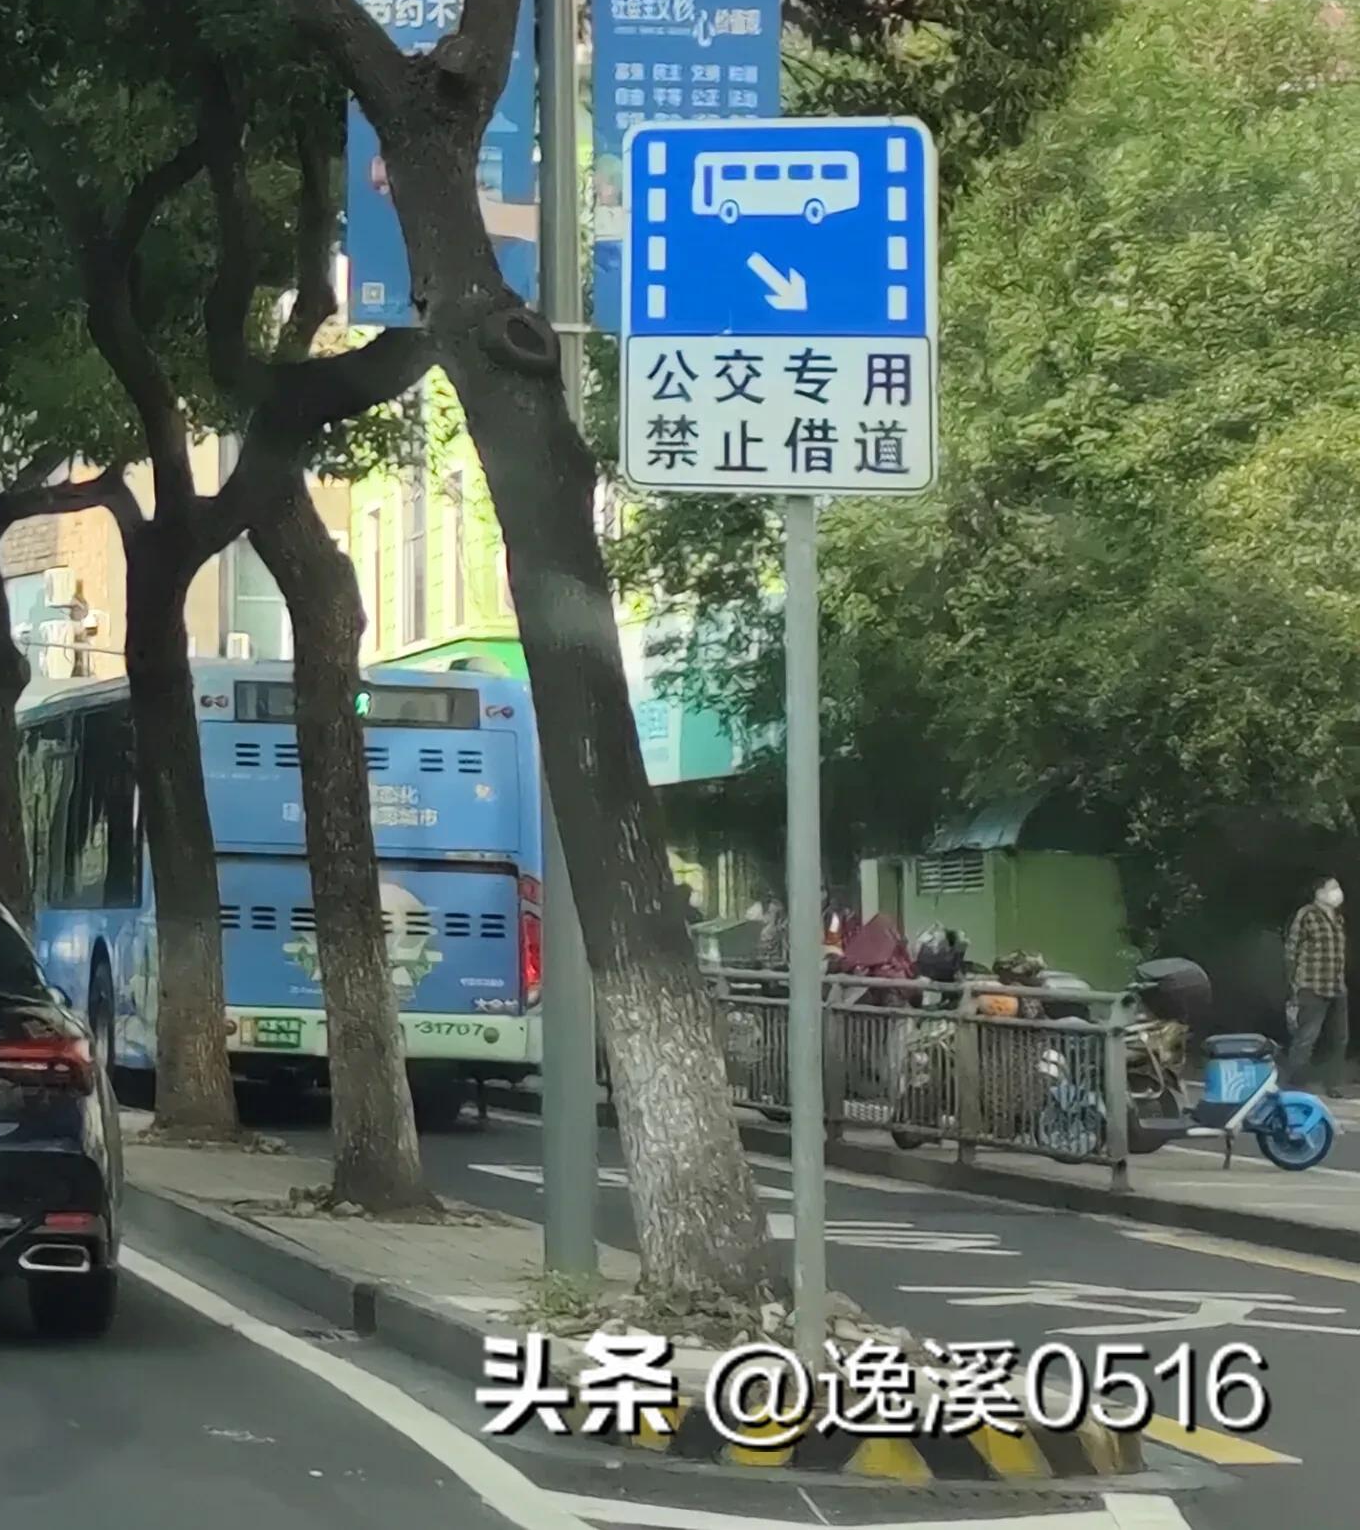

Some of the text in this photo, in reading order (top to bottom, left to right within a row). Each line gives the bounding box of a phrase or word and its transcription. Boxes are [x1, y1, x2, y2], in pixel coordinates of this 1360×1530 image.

[646, 347, 912, 407] 公交专用
[646, 414, 911, 475] 禁止借道
